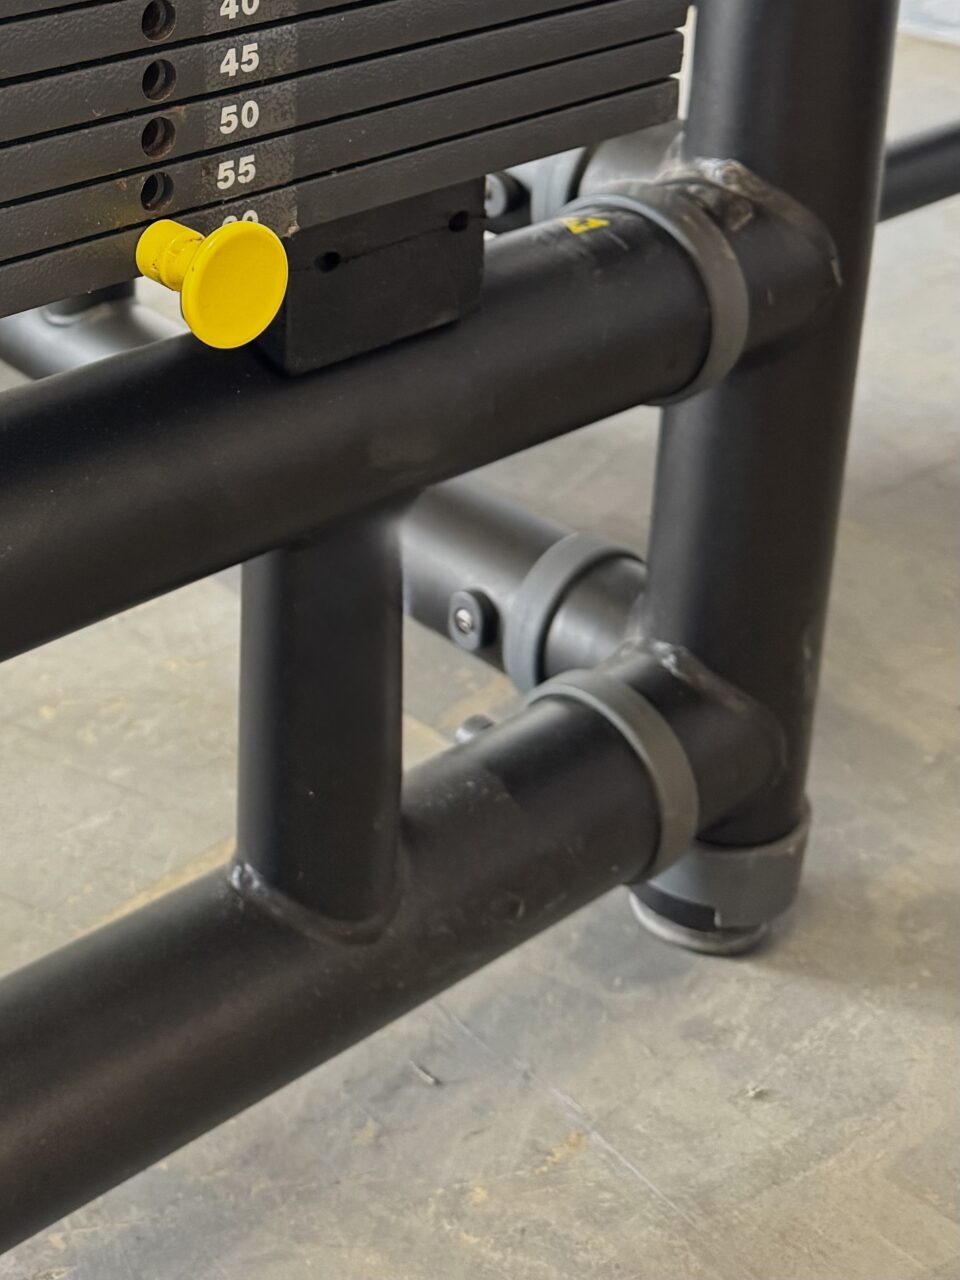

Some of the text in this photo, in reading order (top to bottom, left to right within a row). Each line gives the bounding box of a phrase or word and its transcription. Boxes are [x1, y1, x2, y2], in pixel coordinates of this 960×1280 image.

[219, 42, 260, 77] 45
[219, 100, 259, 134] 50
[216, 154, 256, 190] 55
